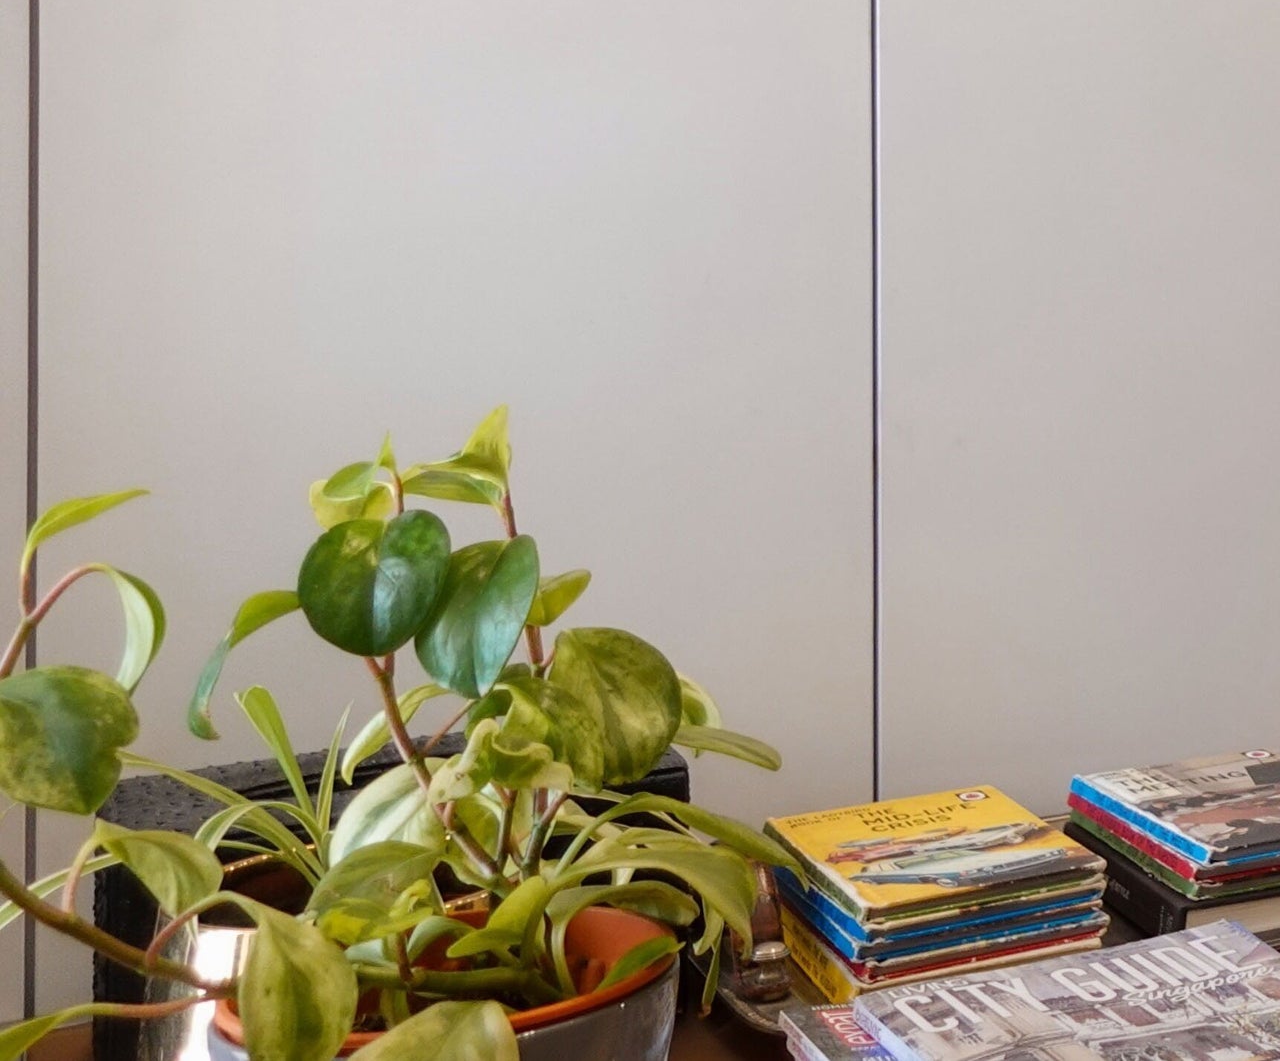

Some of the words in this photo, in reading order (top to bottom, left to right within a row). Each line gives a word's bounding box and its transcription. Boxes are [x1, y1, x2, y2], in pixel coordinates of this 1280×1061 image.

[1113, 774, 1170, 788] THE
[1128, 771, 1247, 795] MEETING
[855, 808, 895, 819] THE
[863, 803, 978, 826] MID-LIFE
[871, 815, 953, 833] CRISIS
[893, 978, 1050, 1034] CITY
[1050, 935, 1263, 1003] GUIDE
[1122, 965, 1277, 1007] Singapore
